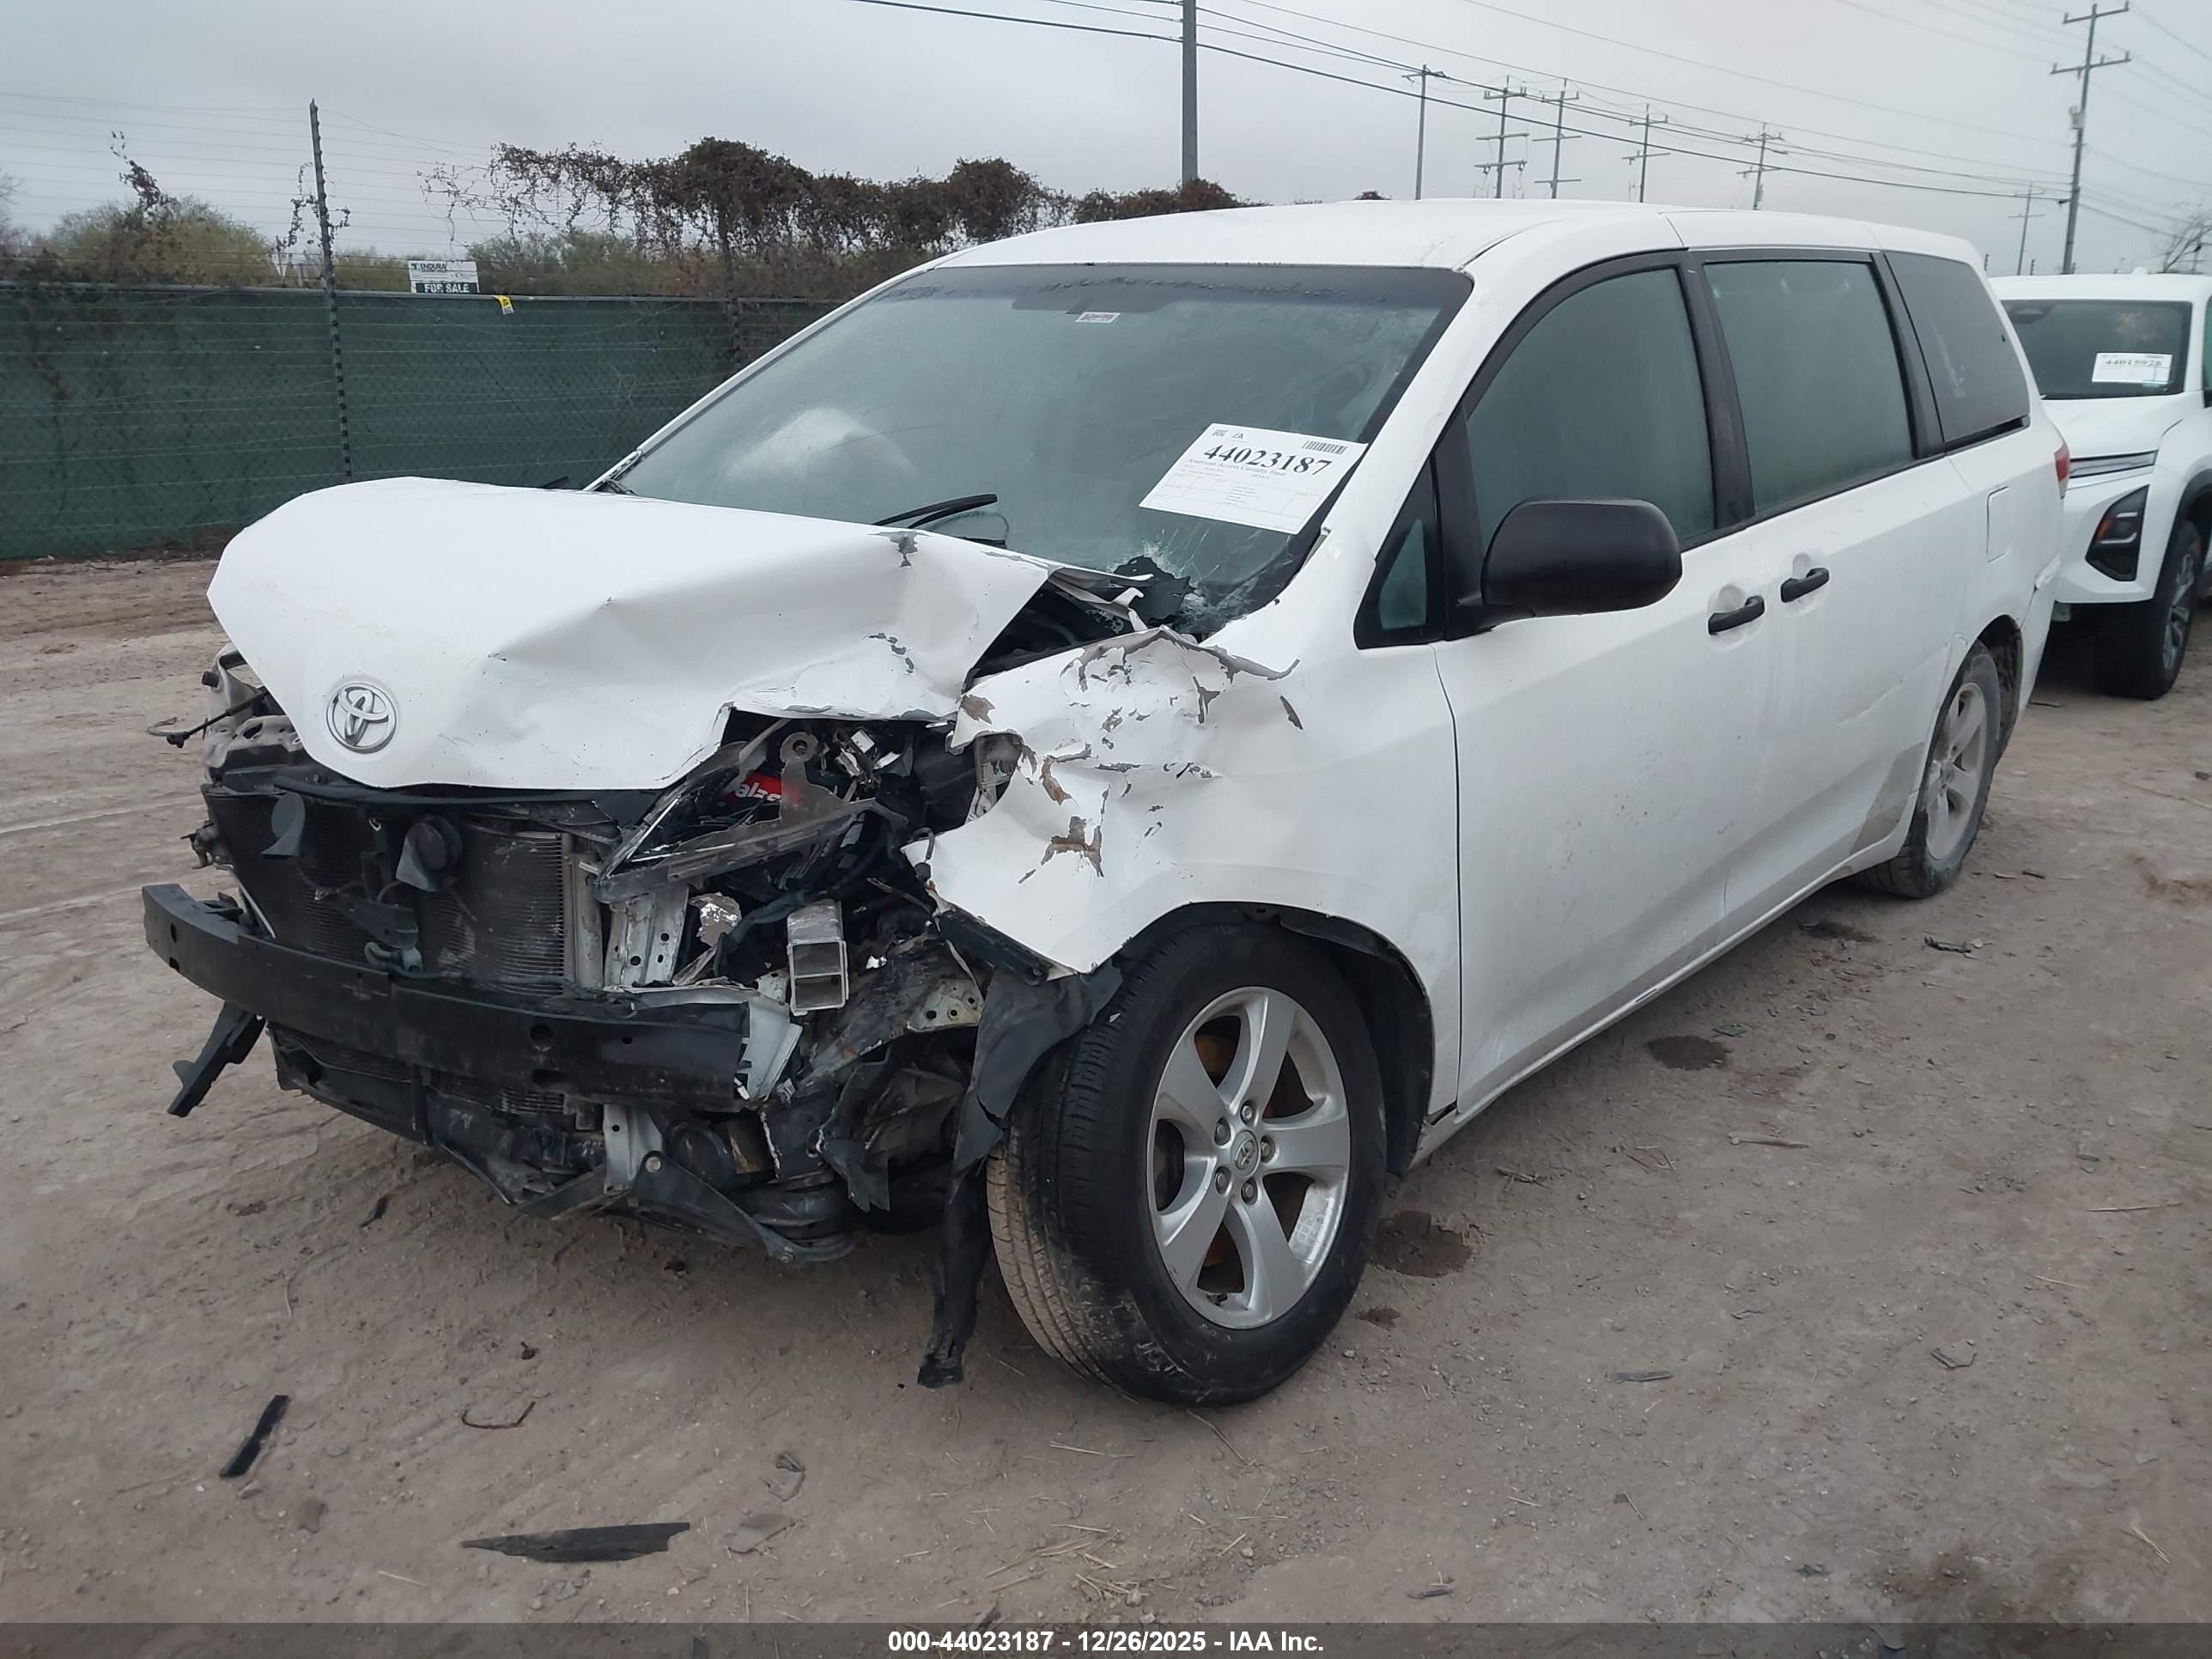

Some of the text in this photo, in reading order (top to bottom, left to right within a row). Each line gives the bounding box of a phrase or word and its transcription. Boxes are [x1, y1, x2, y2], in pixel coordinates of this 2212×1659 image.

[424, 284, 470, 293] FOR SALE
[1203, 444, 1333, 476] 44023187
